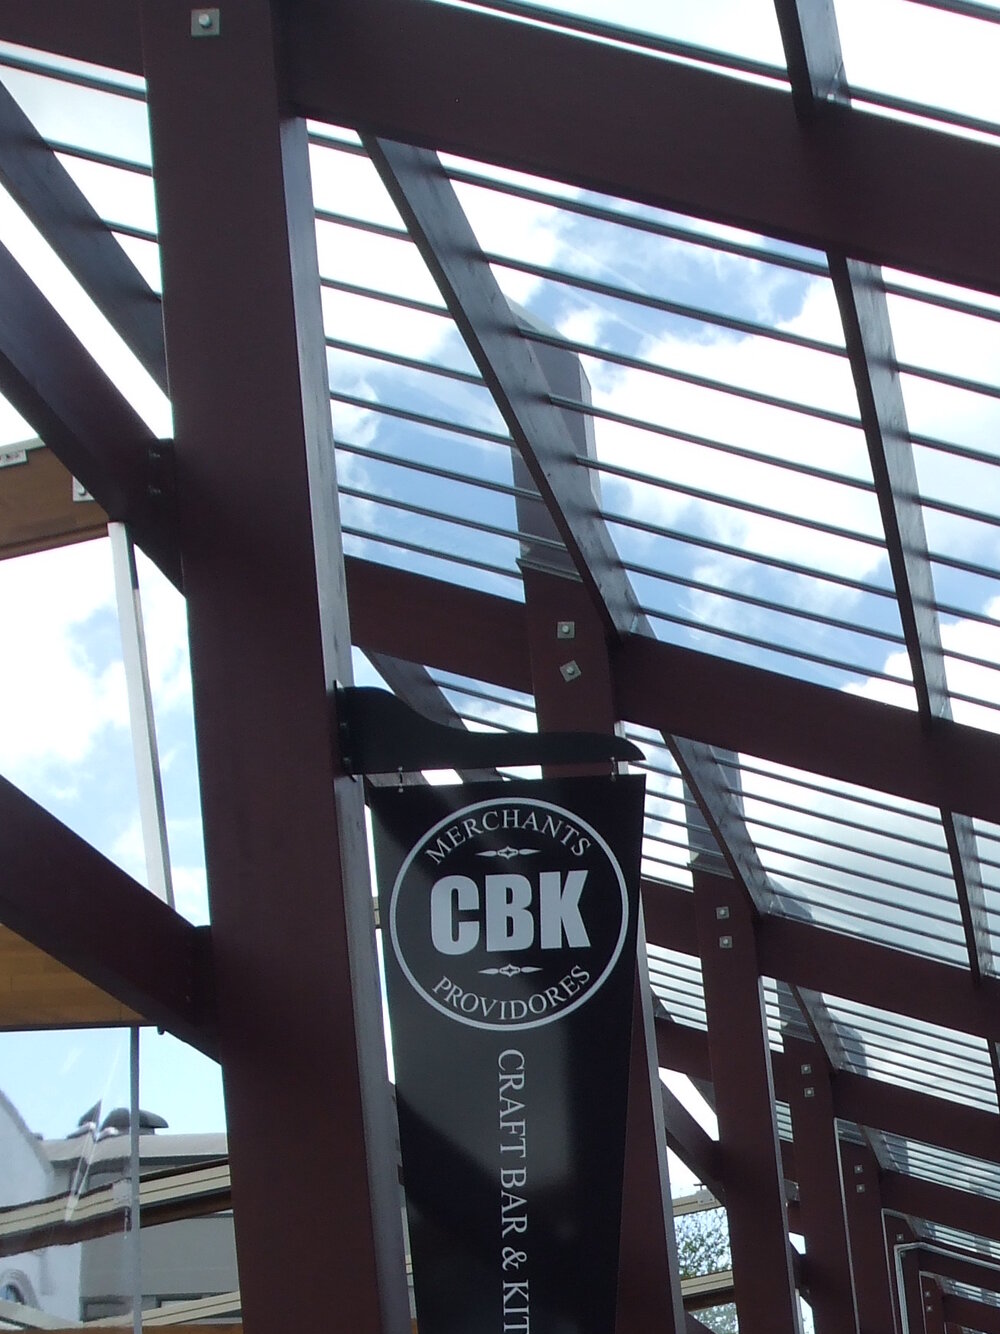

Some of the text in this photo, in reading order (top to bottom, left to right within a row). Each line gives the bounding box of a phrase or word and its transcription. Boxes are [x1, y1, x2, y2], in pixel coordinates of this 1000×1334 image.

[426, 809, 592, 865] MERCHANTS
[430, 870, 591, 955] CBK
[431, 965, 591, 1020] PROVIDORES
[498, 1049, 527, 1158] CRAFT
[500, 1168, 528, 1239] BAR
[501, 1246, 528, 1272] &
